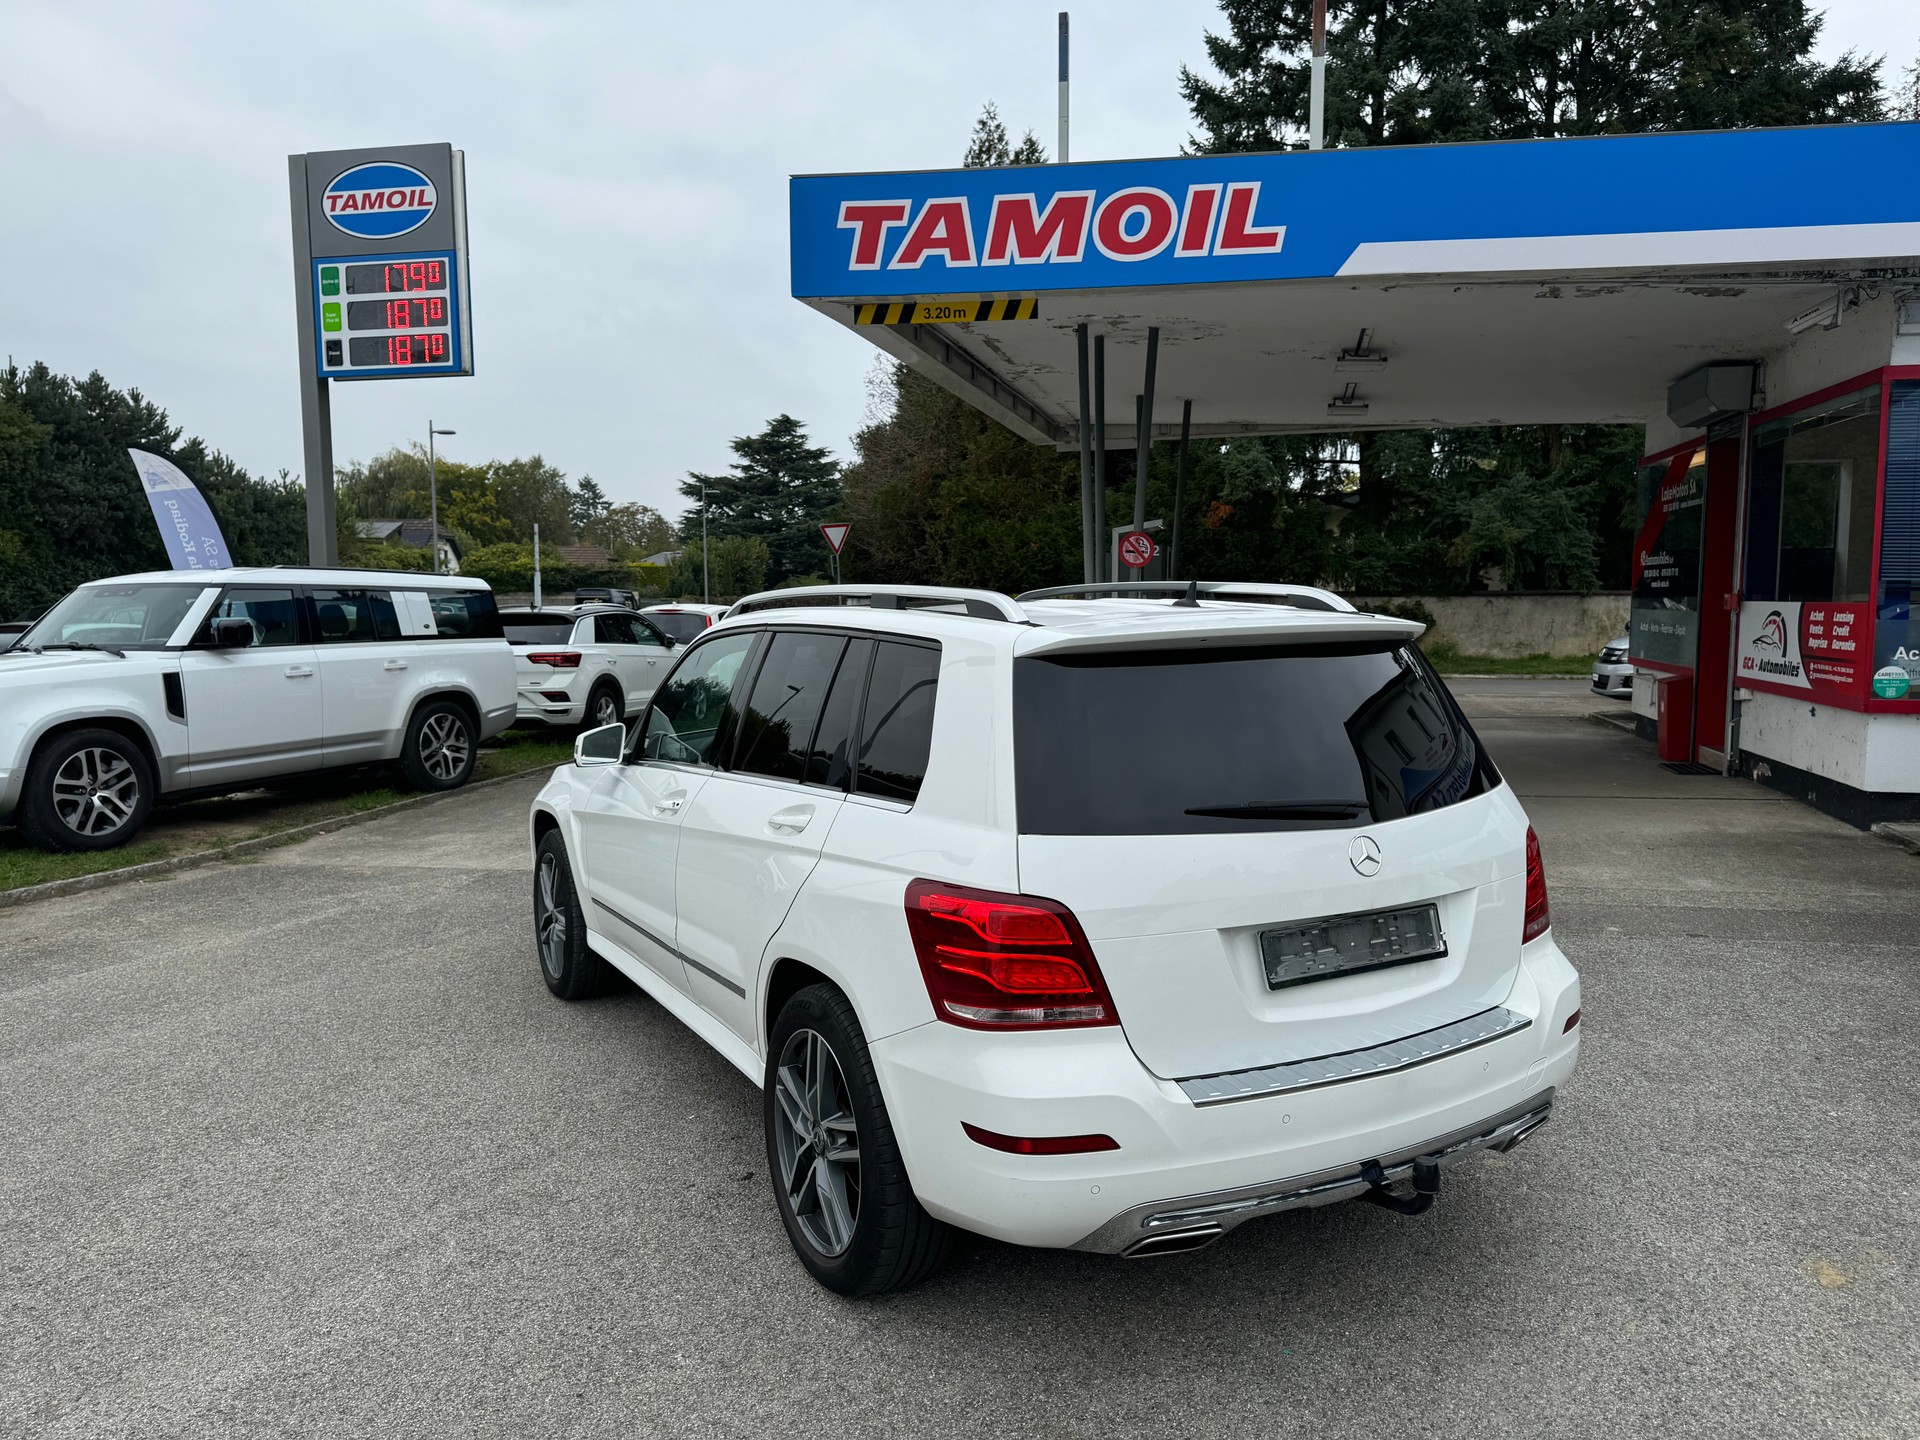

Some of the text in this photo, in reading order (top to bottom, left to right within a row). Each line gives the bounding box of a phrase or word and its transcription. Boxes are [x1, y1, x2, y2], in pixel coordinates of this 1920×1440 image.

[326, 189, 433, 211] TAMOIL
[836, 181, 1287, 271] TAMOIL
[922, 306, 967, 320] 3.20 m
[1810, 610, 1825, 621] Achat
[1833, 611, 1854, 624] Leasing
[1809, 624, 1824, 635] Vente
[1808, 637, 1828, 650] Reprise
[1832, 639, 1856, 651] Garantie
[1742, 656, 1755, 671] GCA
[1758, 658, 1800, 678] Automobiles
